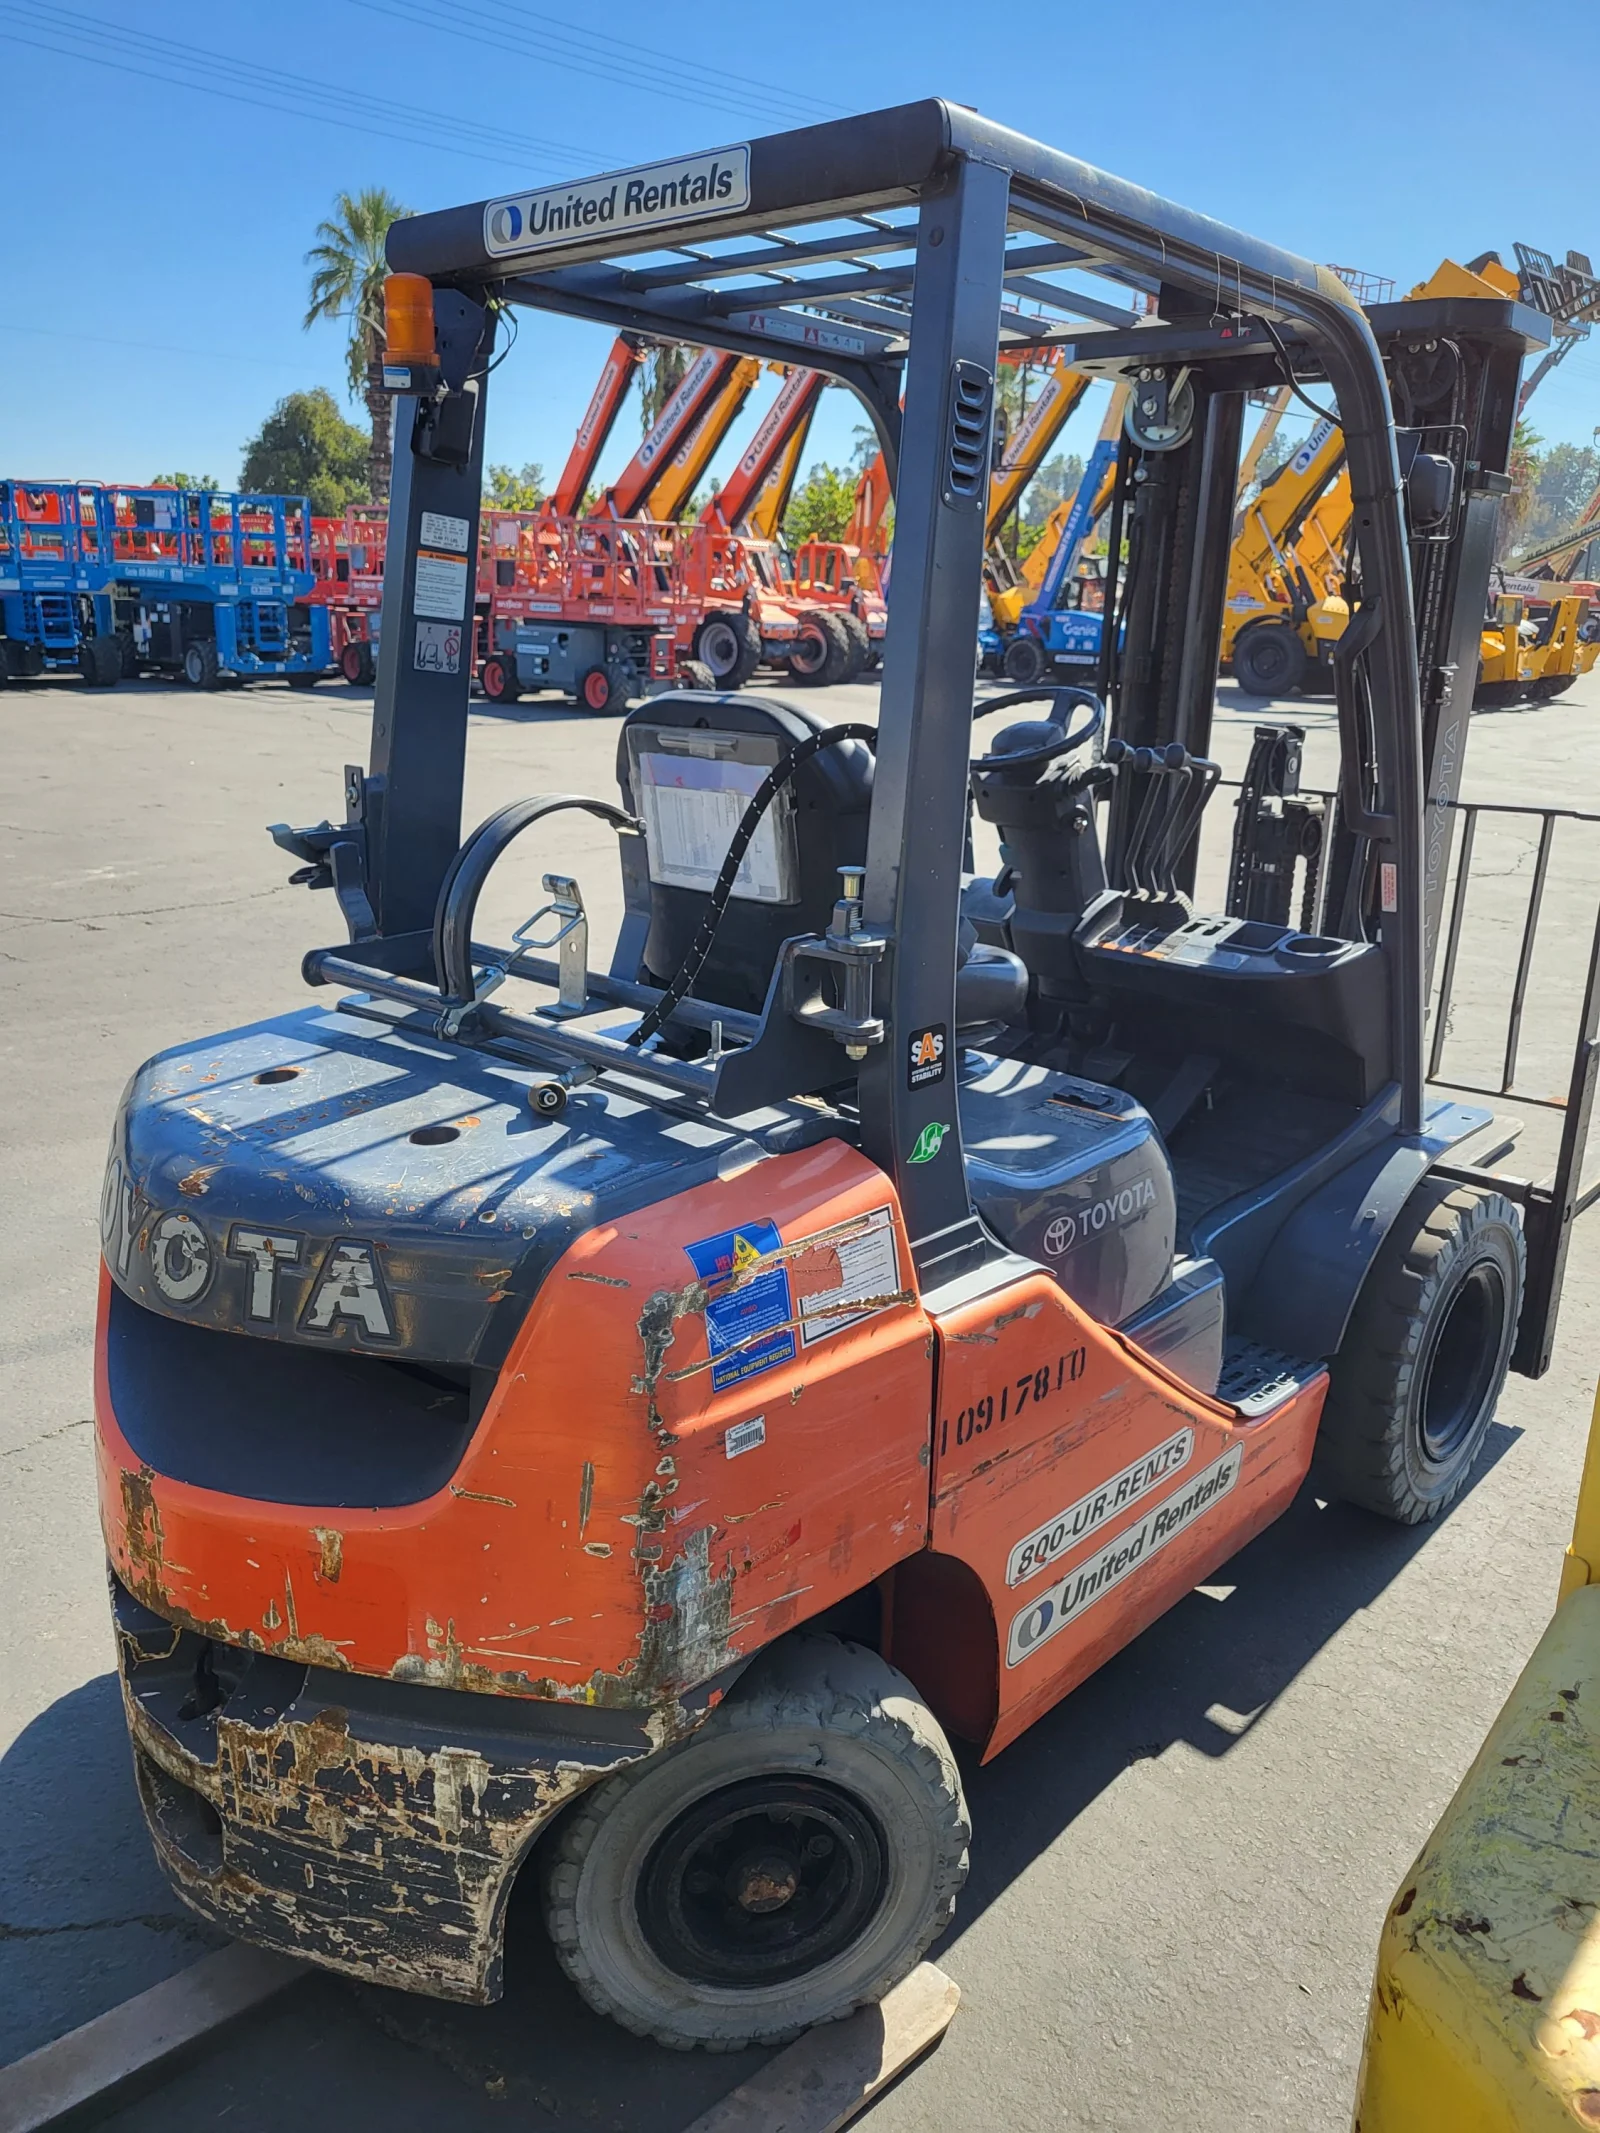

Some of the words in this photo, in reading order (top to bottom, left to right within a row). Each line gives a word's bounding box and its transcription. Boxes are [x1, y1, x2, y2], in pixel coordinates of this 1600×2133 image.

[529, 185, 618, 236] United
[624, 163, 733, 217] Rentals
[652, 405, 683, 447] United
[680, 357, 713, 407] Rentals
[755, 411, 780, 457] United
[1063, 622, 1098, 637] Genie
[1425, 720, 1460, 901] TOYOTA
[911, 1032, 944, 1066] SAS
[911, 1067, 942, 1083] STABILITY
[1079, 1178, 1156, 1236] TOYOTA
[101, 1155, 394, 1336] OYOTA
[715, 1369, 741, 1386] NATIONAL
[740, 1354, 769, 1375] EQUIPMENT
[768, 1346, 792, 1366] REGISTER
[941, 1346, 1086, 1457] 10917810
[1017, 1437, 1187, 1575] 800-UR-RENTS
[1060, 1527, 1146, 1616] United
[1150, 1465, 1231, 1548] Rentals
